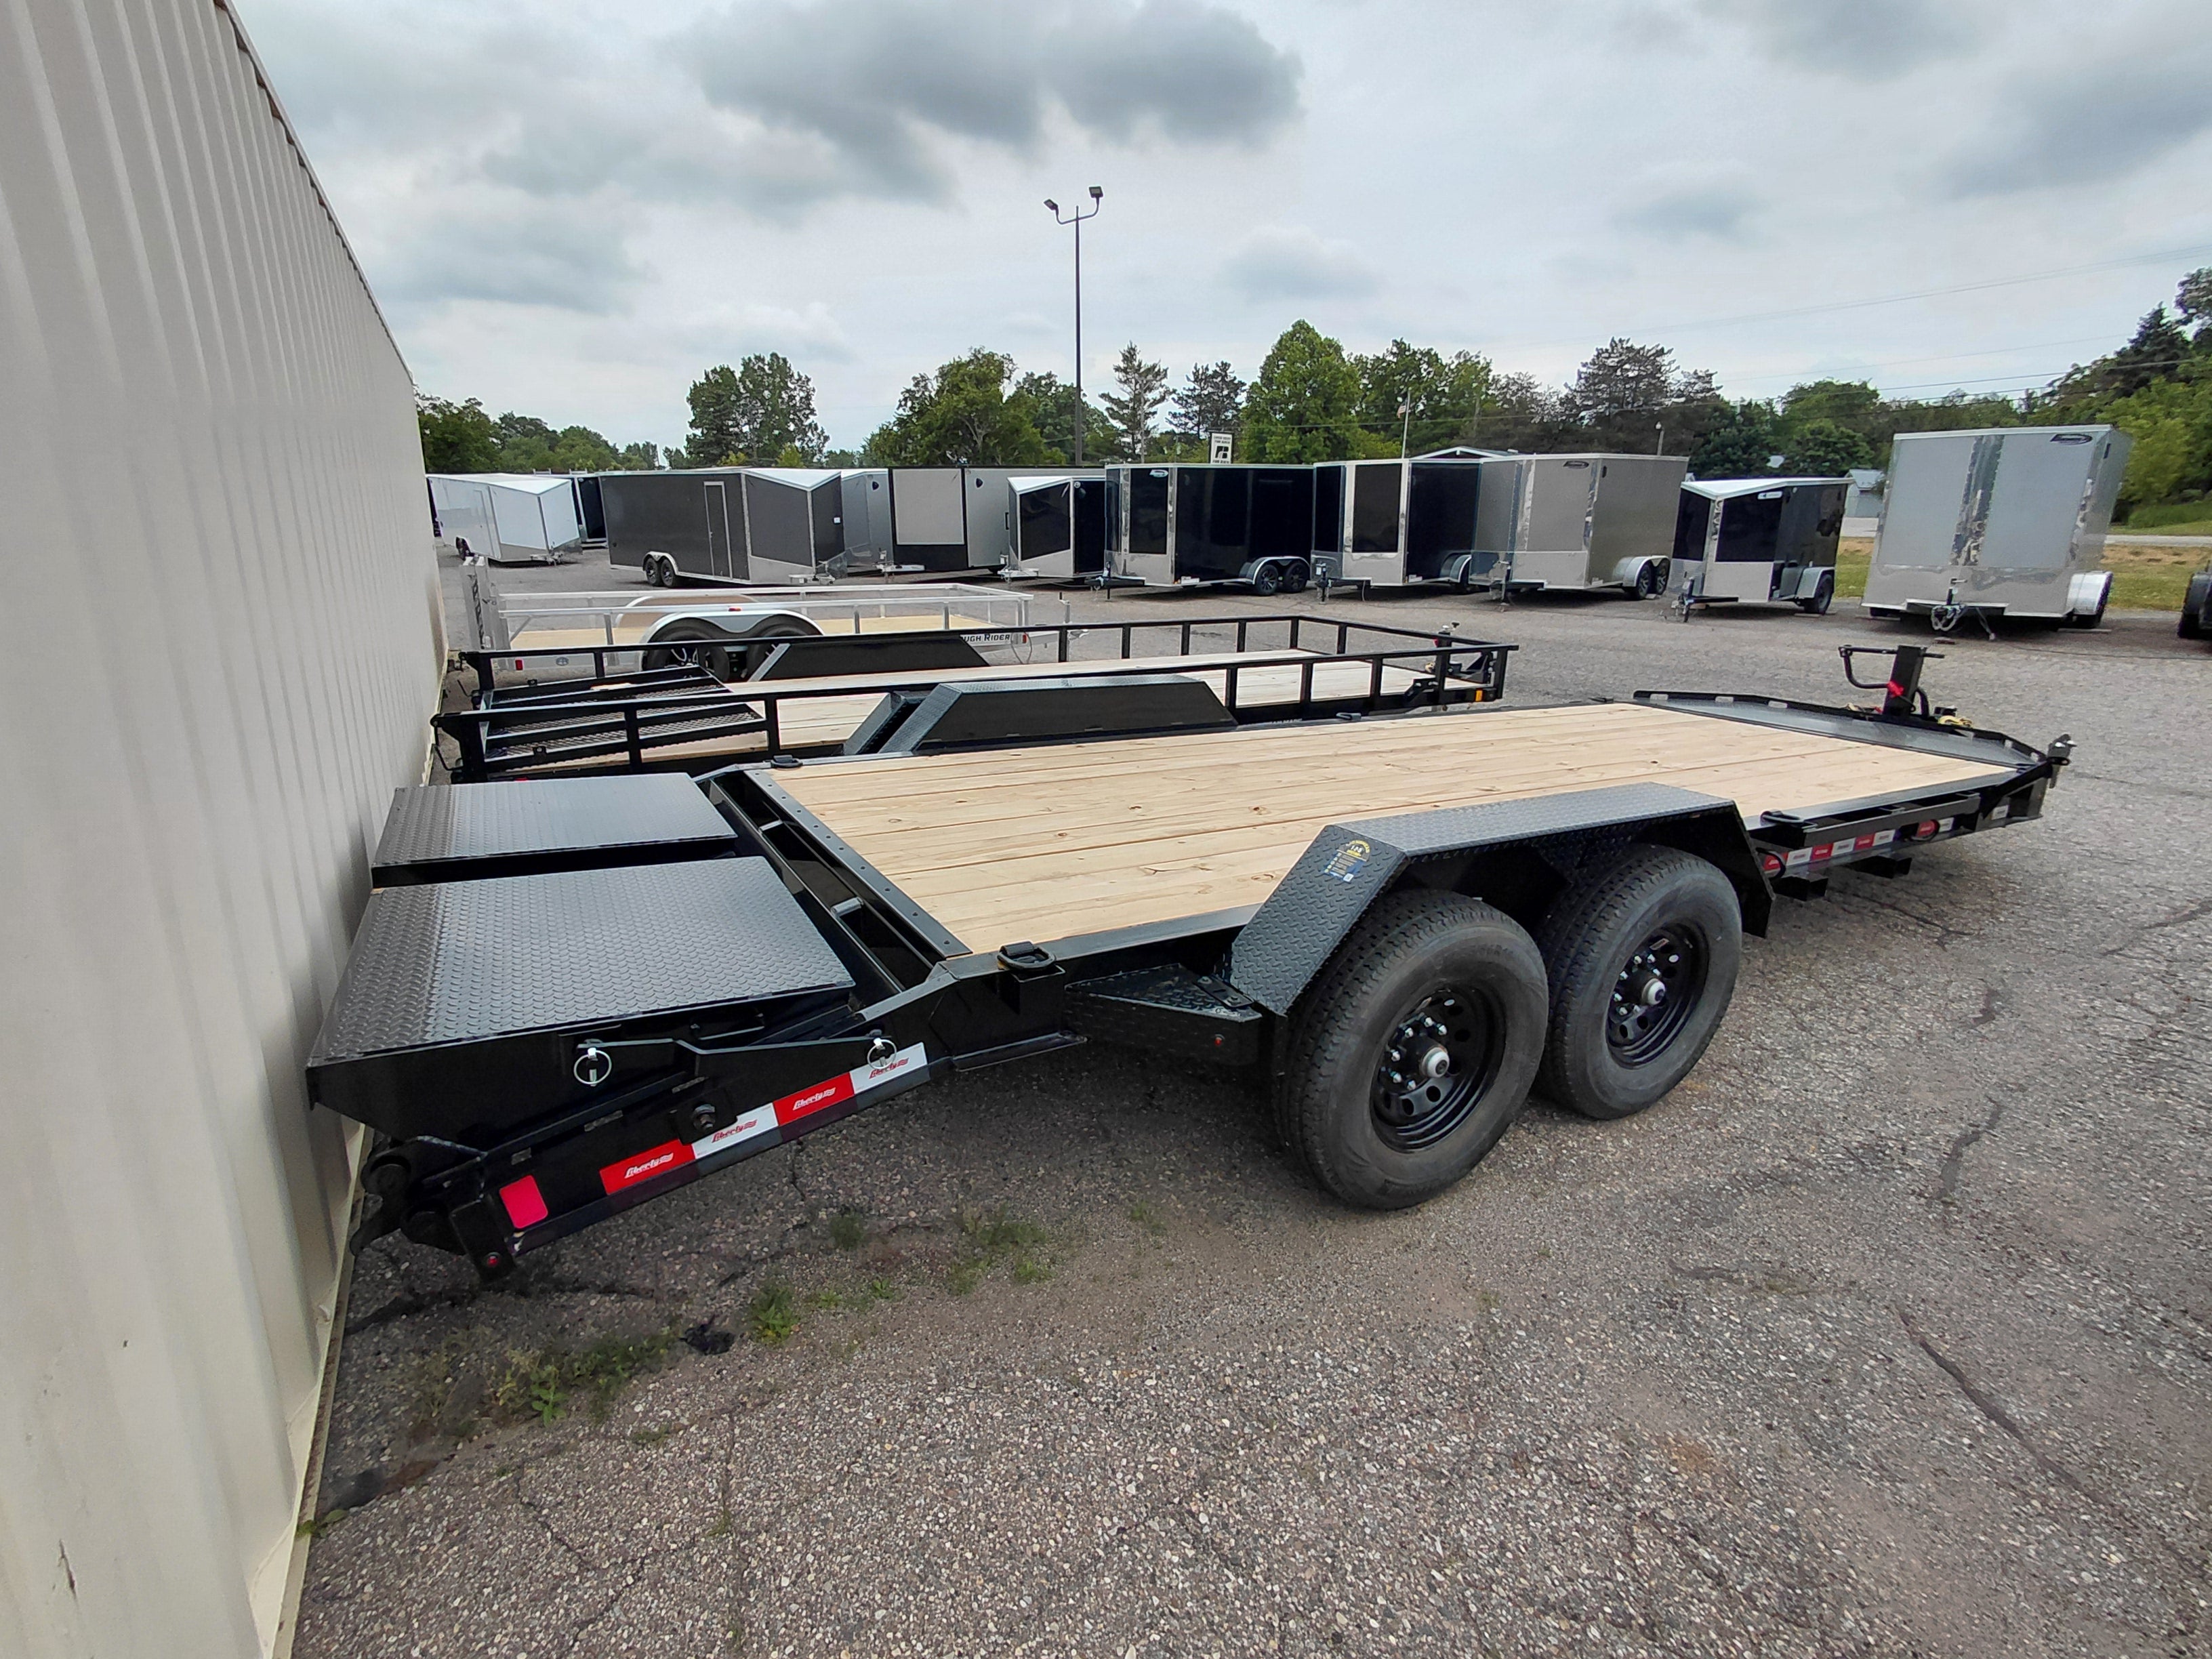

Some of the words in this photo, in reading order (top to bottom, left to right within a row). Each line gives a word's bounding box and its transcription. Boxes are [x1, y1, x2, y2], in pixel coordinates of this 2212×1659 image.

[984, 633, 1010, 642] RIDER
[712, 1124, 745, 1143] Liberty
[624, 1156, 661, 1179] Liberty
